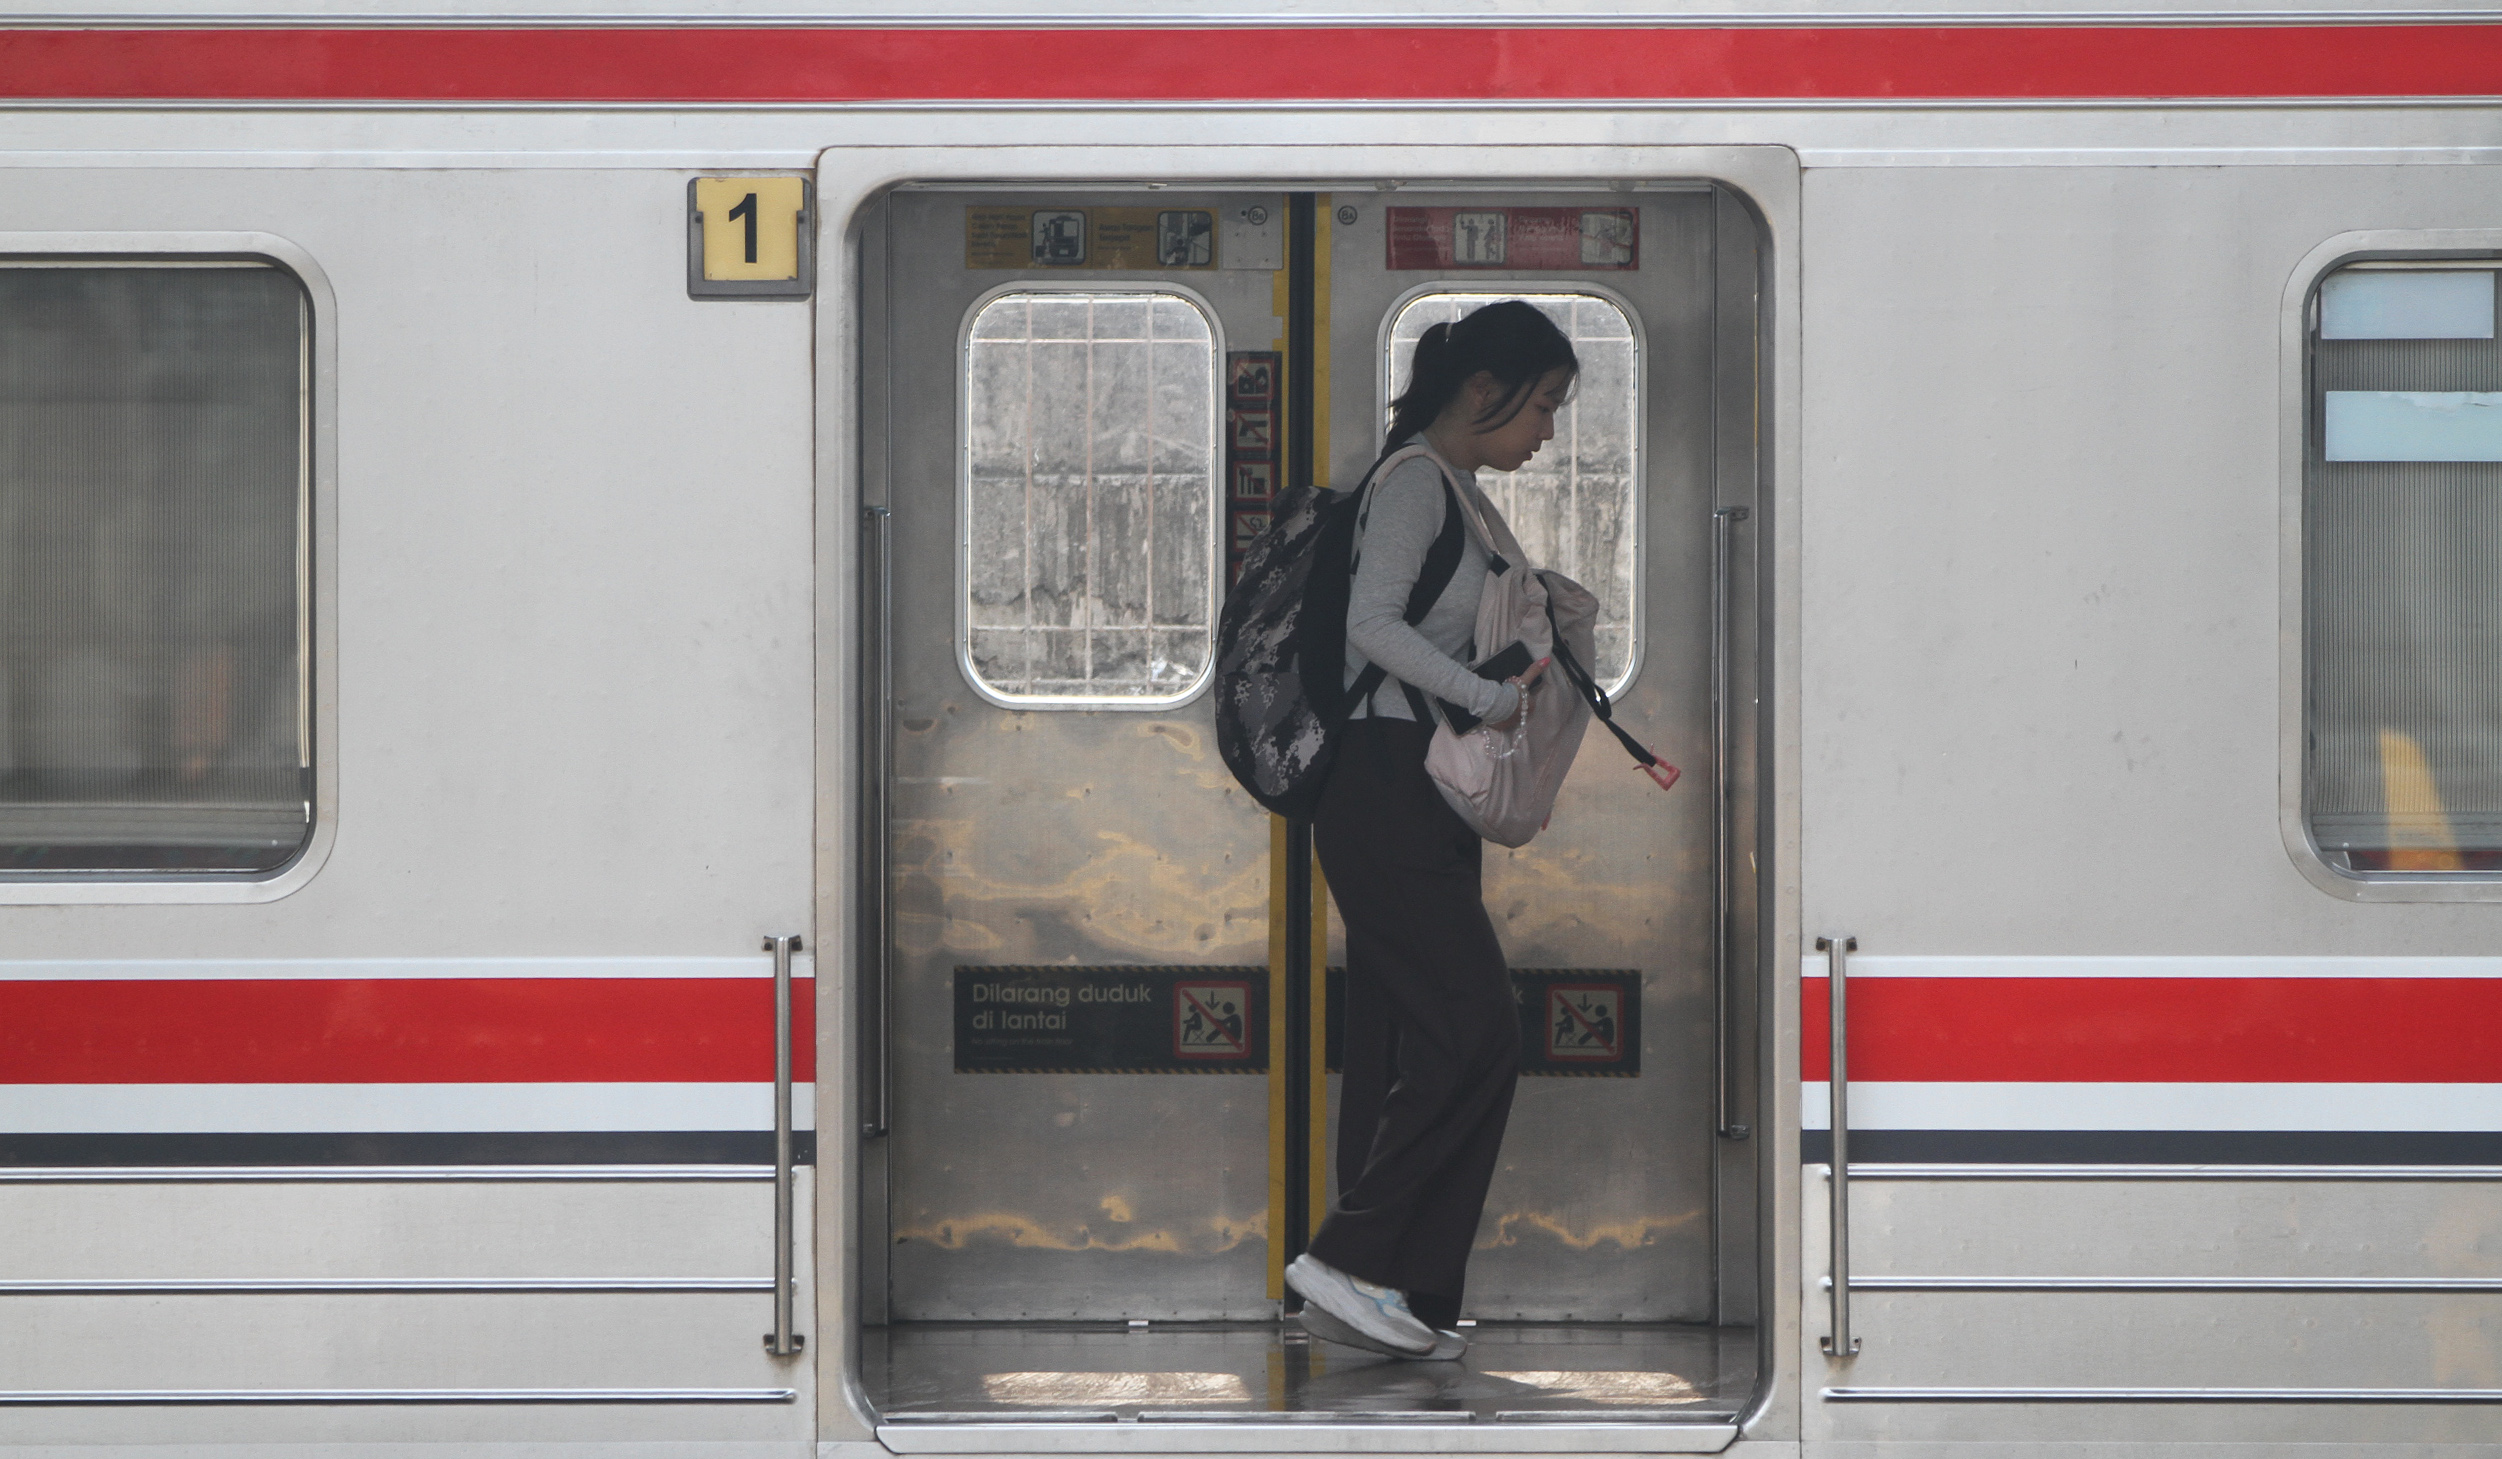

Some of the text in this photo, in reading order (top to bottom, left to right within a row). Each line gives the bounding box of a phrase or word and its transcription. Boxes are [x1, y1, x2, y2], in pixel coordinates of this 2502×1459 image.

[728, 193, 757, 263] 1
[973, 984, 1151, 1007] Dilarang duduk
[972, 1010, 1067, 1030] di lantai
